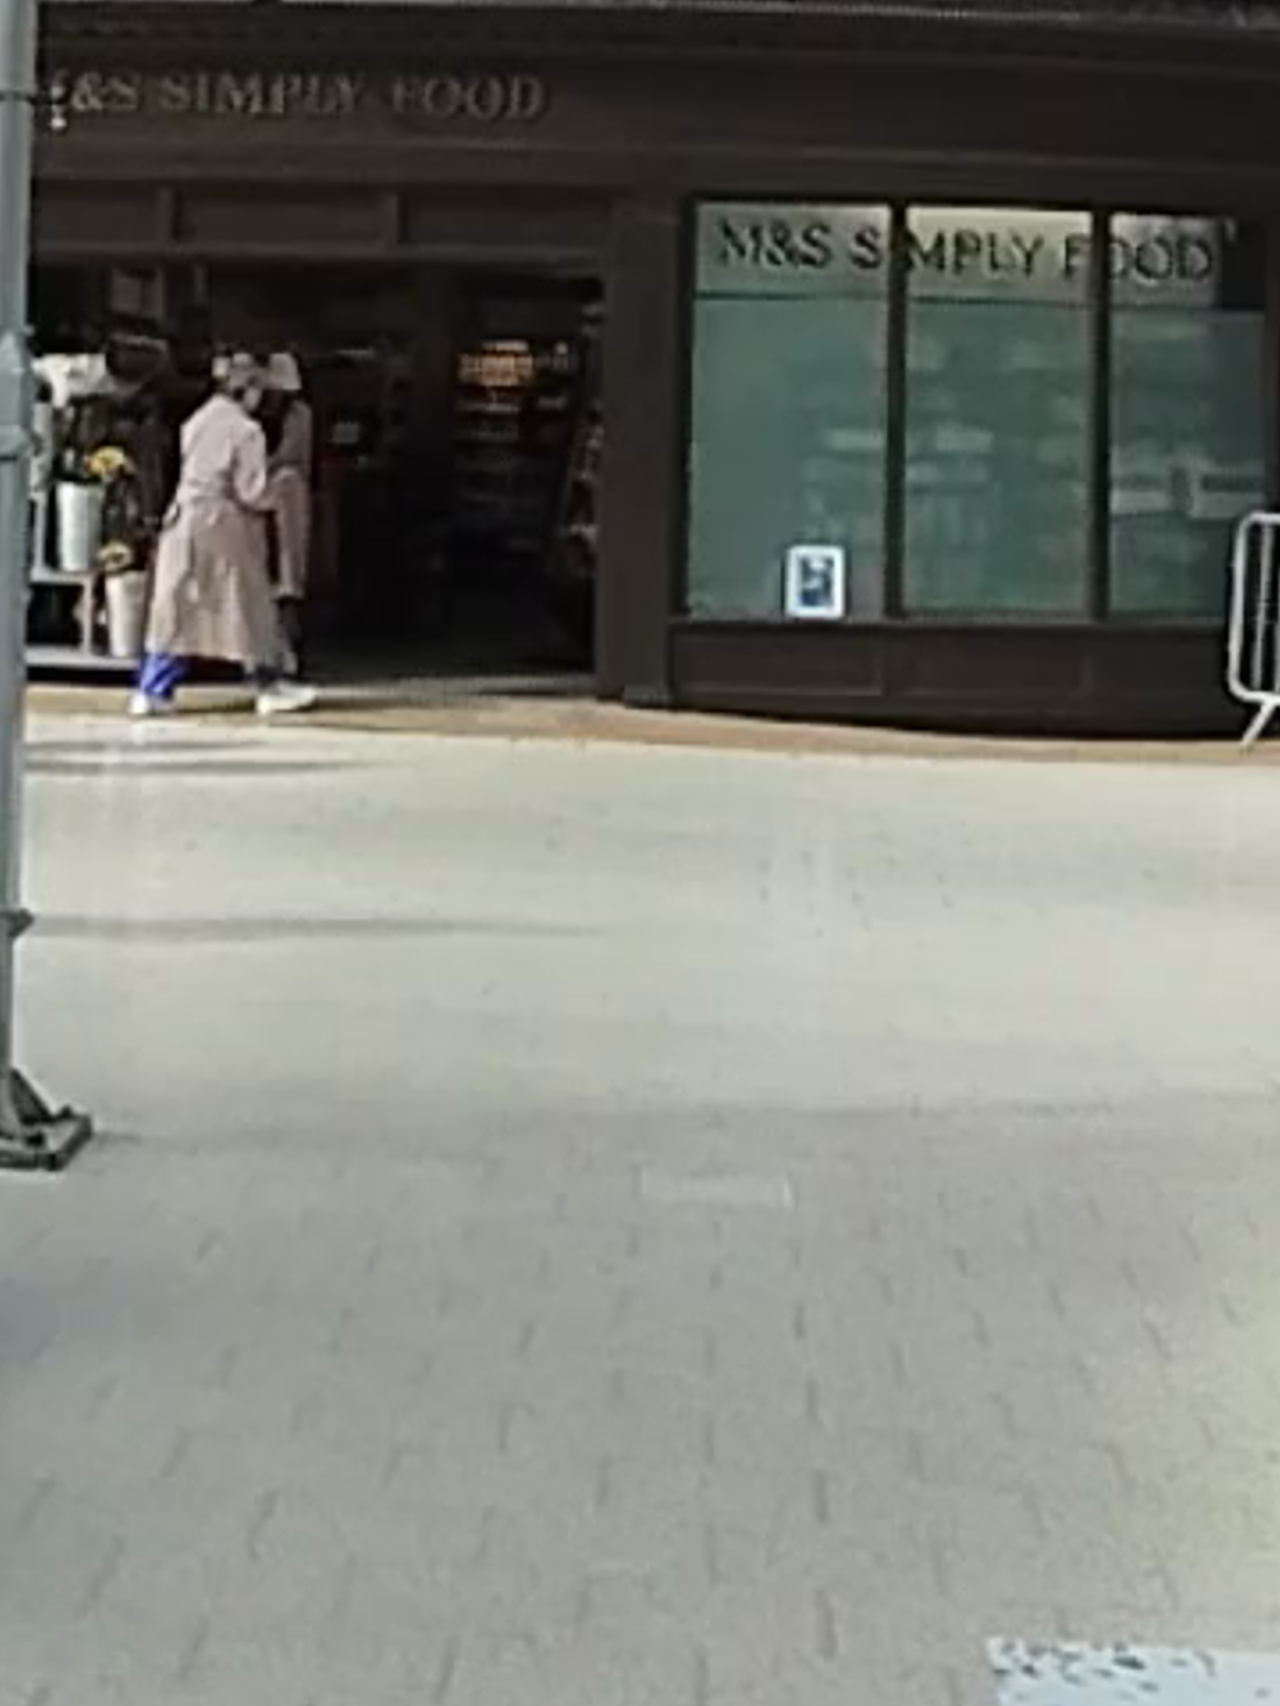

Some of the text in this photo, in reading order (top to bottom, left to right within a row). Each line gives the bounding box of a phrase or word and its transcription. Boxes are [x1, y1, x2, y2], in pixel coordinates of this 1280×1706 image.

[160, 70, 361, 115] SIMPLY
[393, 75, 545, 121] FOOD
[720, 218, 831, 270] M&S
[852, 226, 1045, 275] SMPLY
